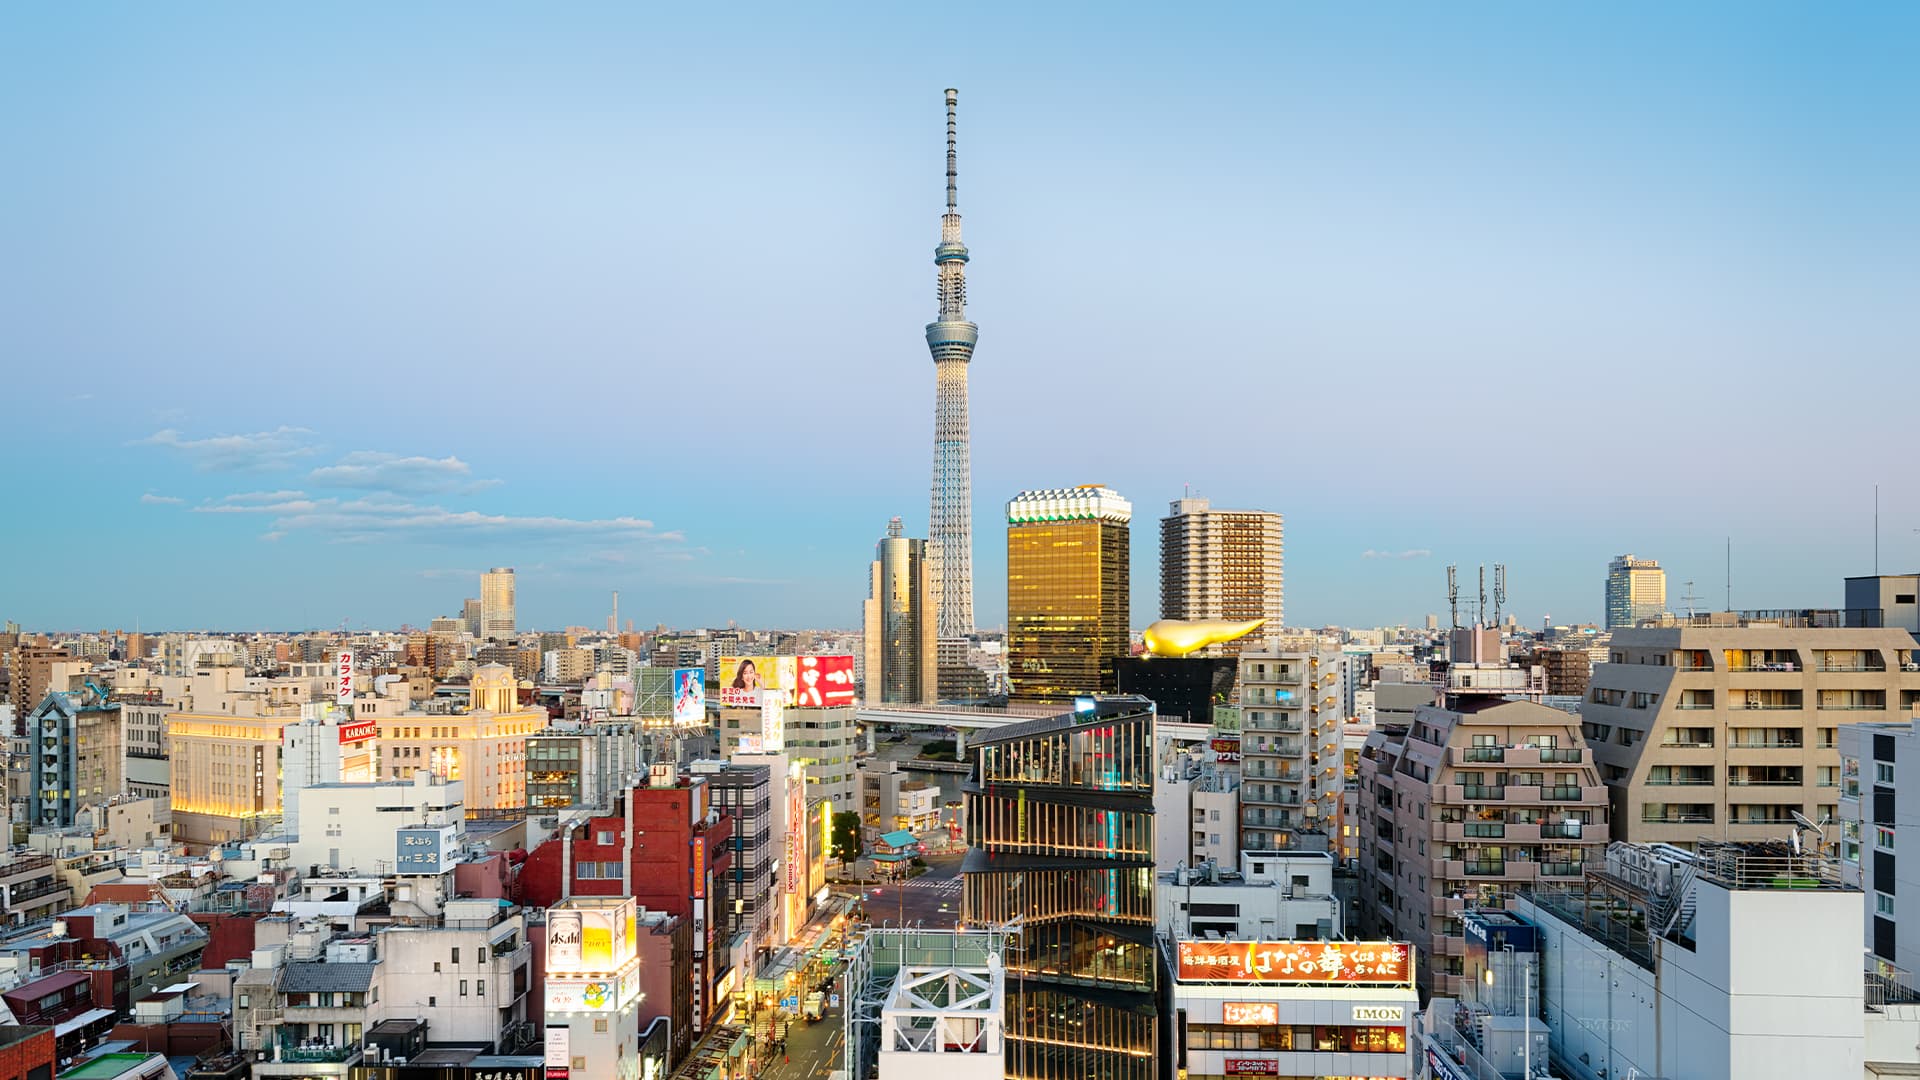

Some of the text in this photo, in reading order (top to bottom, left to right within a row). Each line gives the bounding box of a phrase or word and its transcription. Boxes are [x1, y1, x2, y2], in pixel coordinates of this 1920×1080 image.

[340, 653, 351, 697] カラオケ
[345, 725, 375, 738] KARAOKE
[405, 836, 432, 846] 天ぷら
[551, 931, 580, 945] Asahi
[1245, 944, 1347, 979] はなの舞
[1355, 1008, 1402, 1020] IMON
